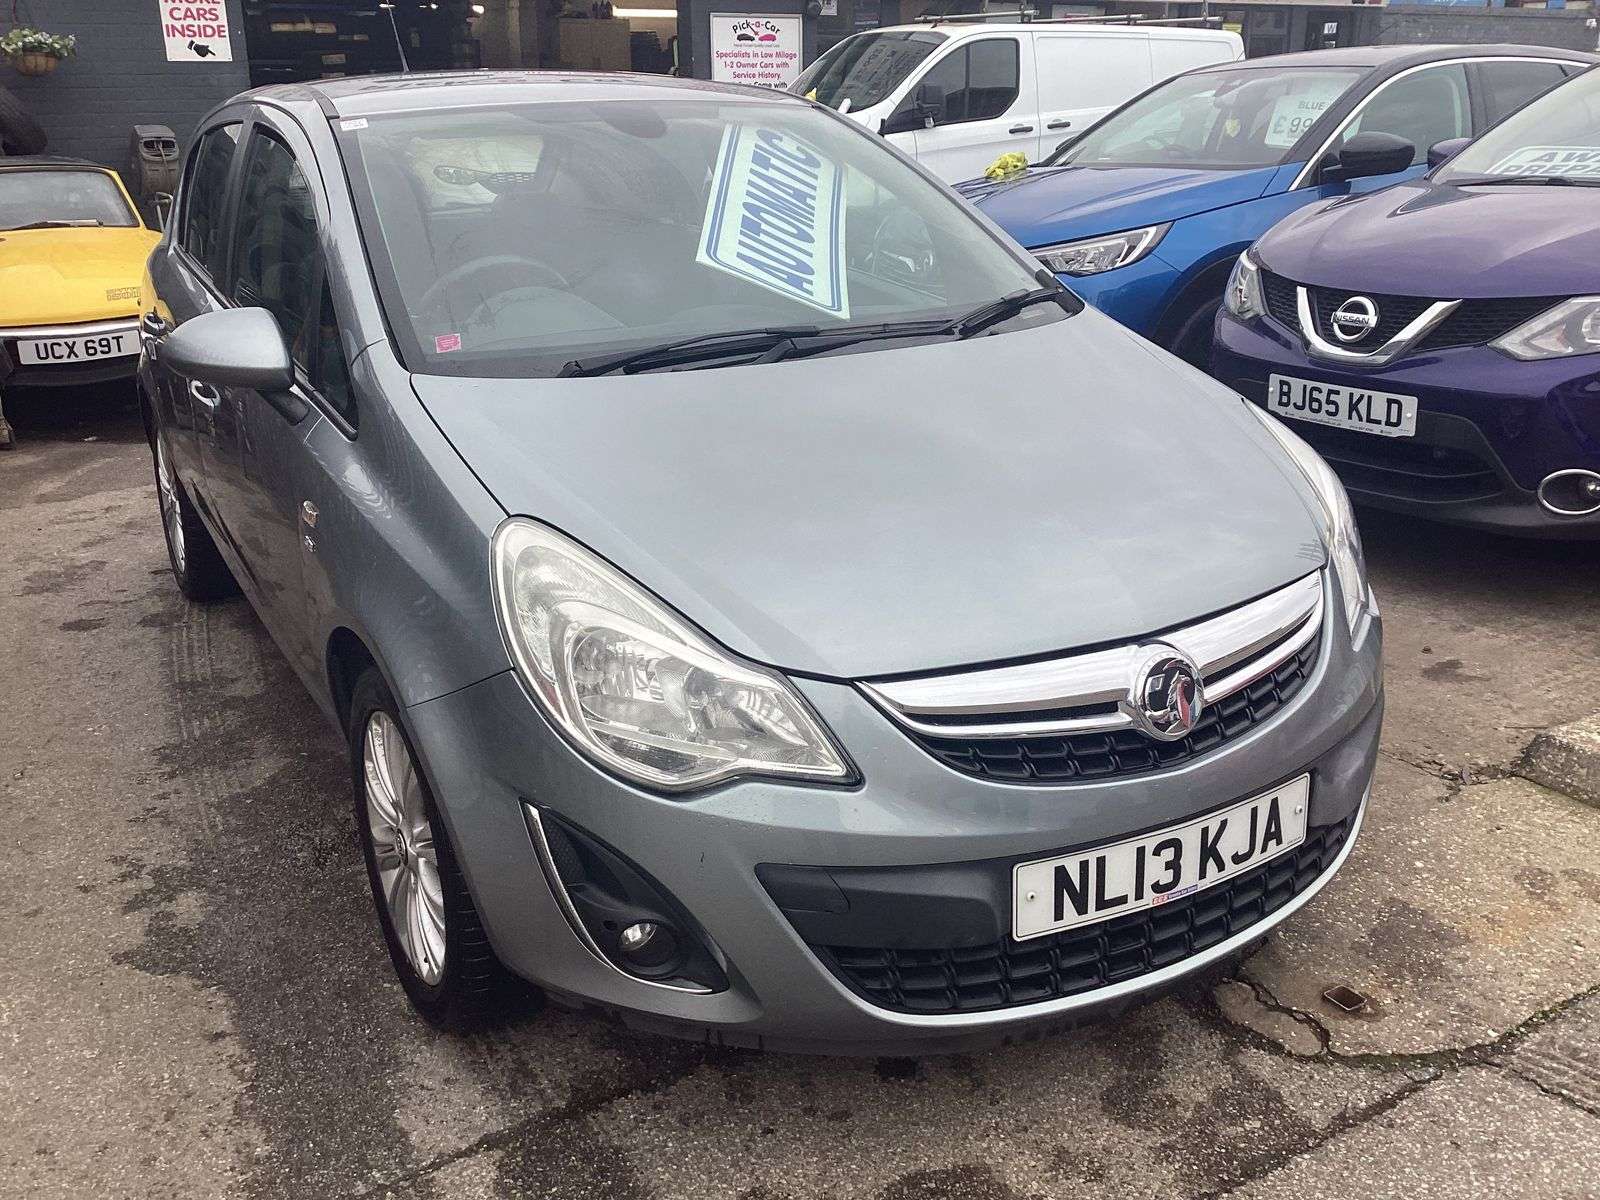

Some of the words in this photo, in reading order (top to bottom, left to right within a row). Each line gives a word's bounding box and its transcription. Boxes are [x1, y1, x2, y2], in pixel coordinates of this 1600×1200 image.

[169, 7, 219, 21] CARS
[165, 24, 226, 38] INSIDE
[715, 50, 751, 59] Specialists
[761, 51, 773, 59] Low
[736, 61, 758, 69] Owner
[760, 61, 774, 69] Cars
[775, 61, 790, 69] with
[733, 71, 756, 79] Service
[773, 81, 788, 89] with
[1298, 101, 1326, 110] BLUE
[736, 128, 822, 297] AUTOMATIC
[1332, 312, 1370, 326] NISSAN
[35, 341, 79, 360] UCX
[84, 335, 123, 357] 69T
[1277, 379, 1341, 417] BJ65
[1347, 391, 1403, 428] KLD
[1053, 837, 1184, 923] NL13
[1198, 796, 1283, 881] KJA
